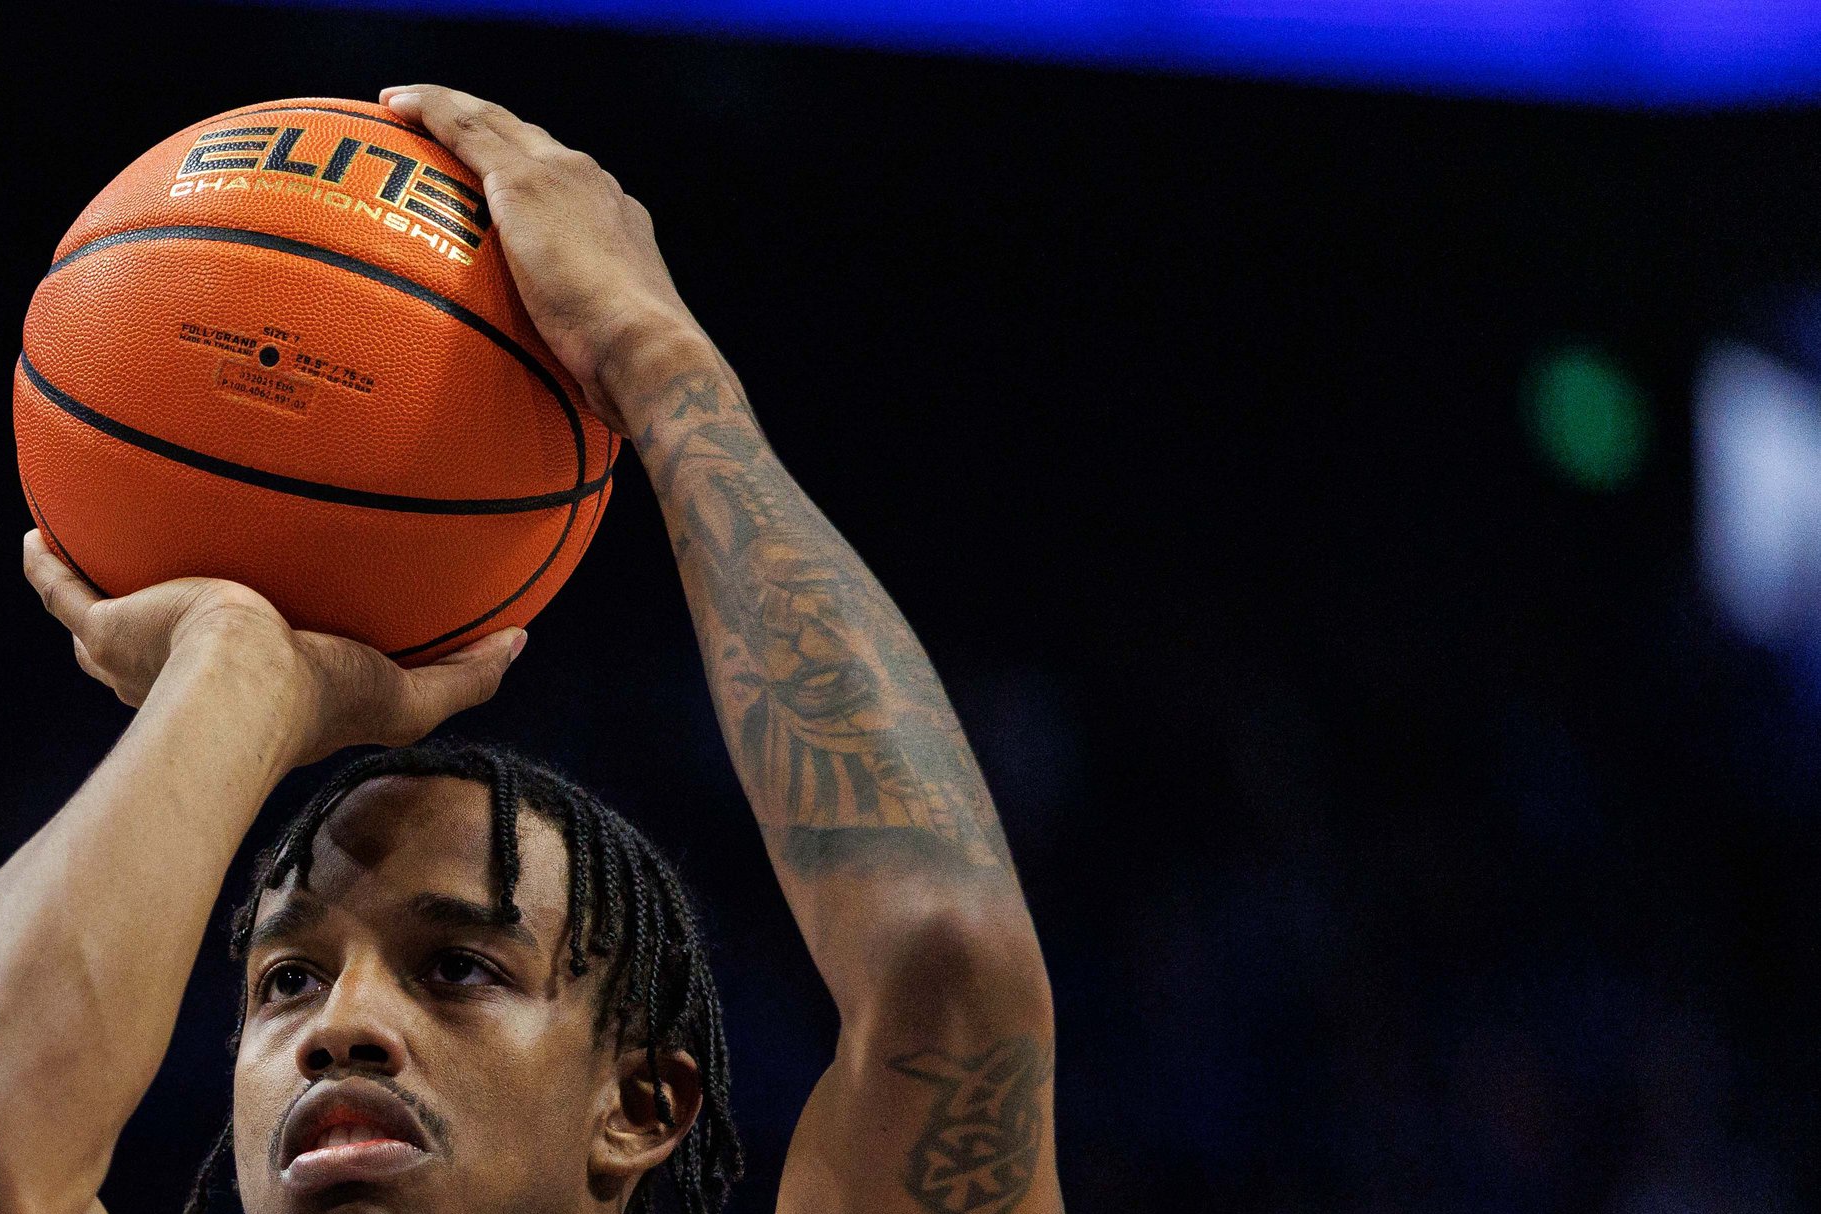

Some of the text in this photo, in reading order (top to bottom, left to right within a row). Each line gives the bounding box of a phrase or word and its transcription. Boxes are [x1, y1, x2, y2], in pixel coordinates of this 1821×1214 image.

[177, 126, 490, 250] ELITE
[169, 177, 475, 266] CHAMPIONSHIP
[181, 323, 258, 348] FULL/GRAND
[262, 326, 300, 344] SIZE 7
[214, 342, 253, 357] THAILAND
[343, 368, 356, 380] 75
